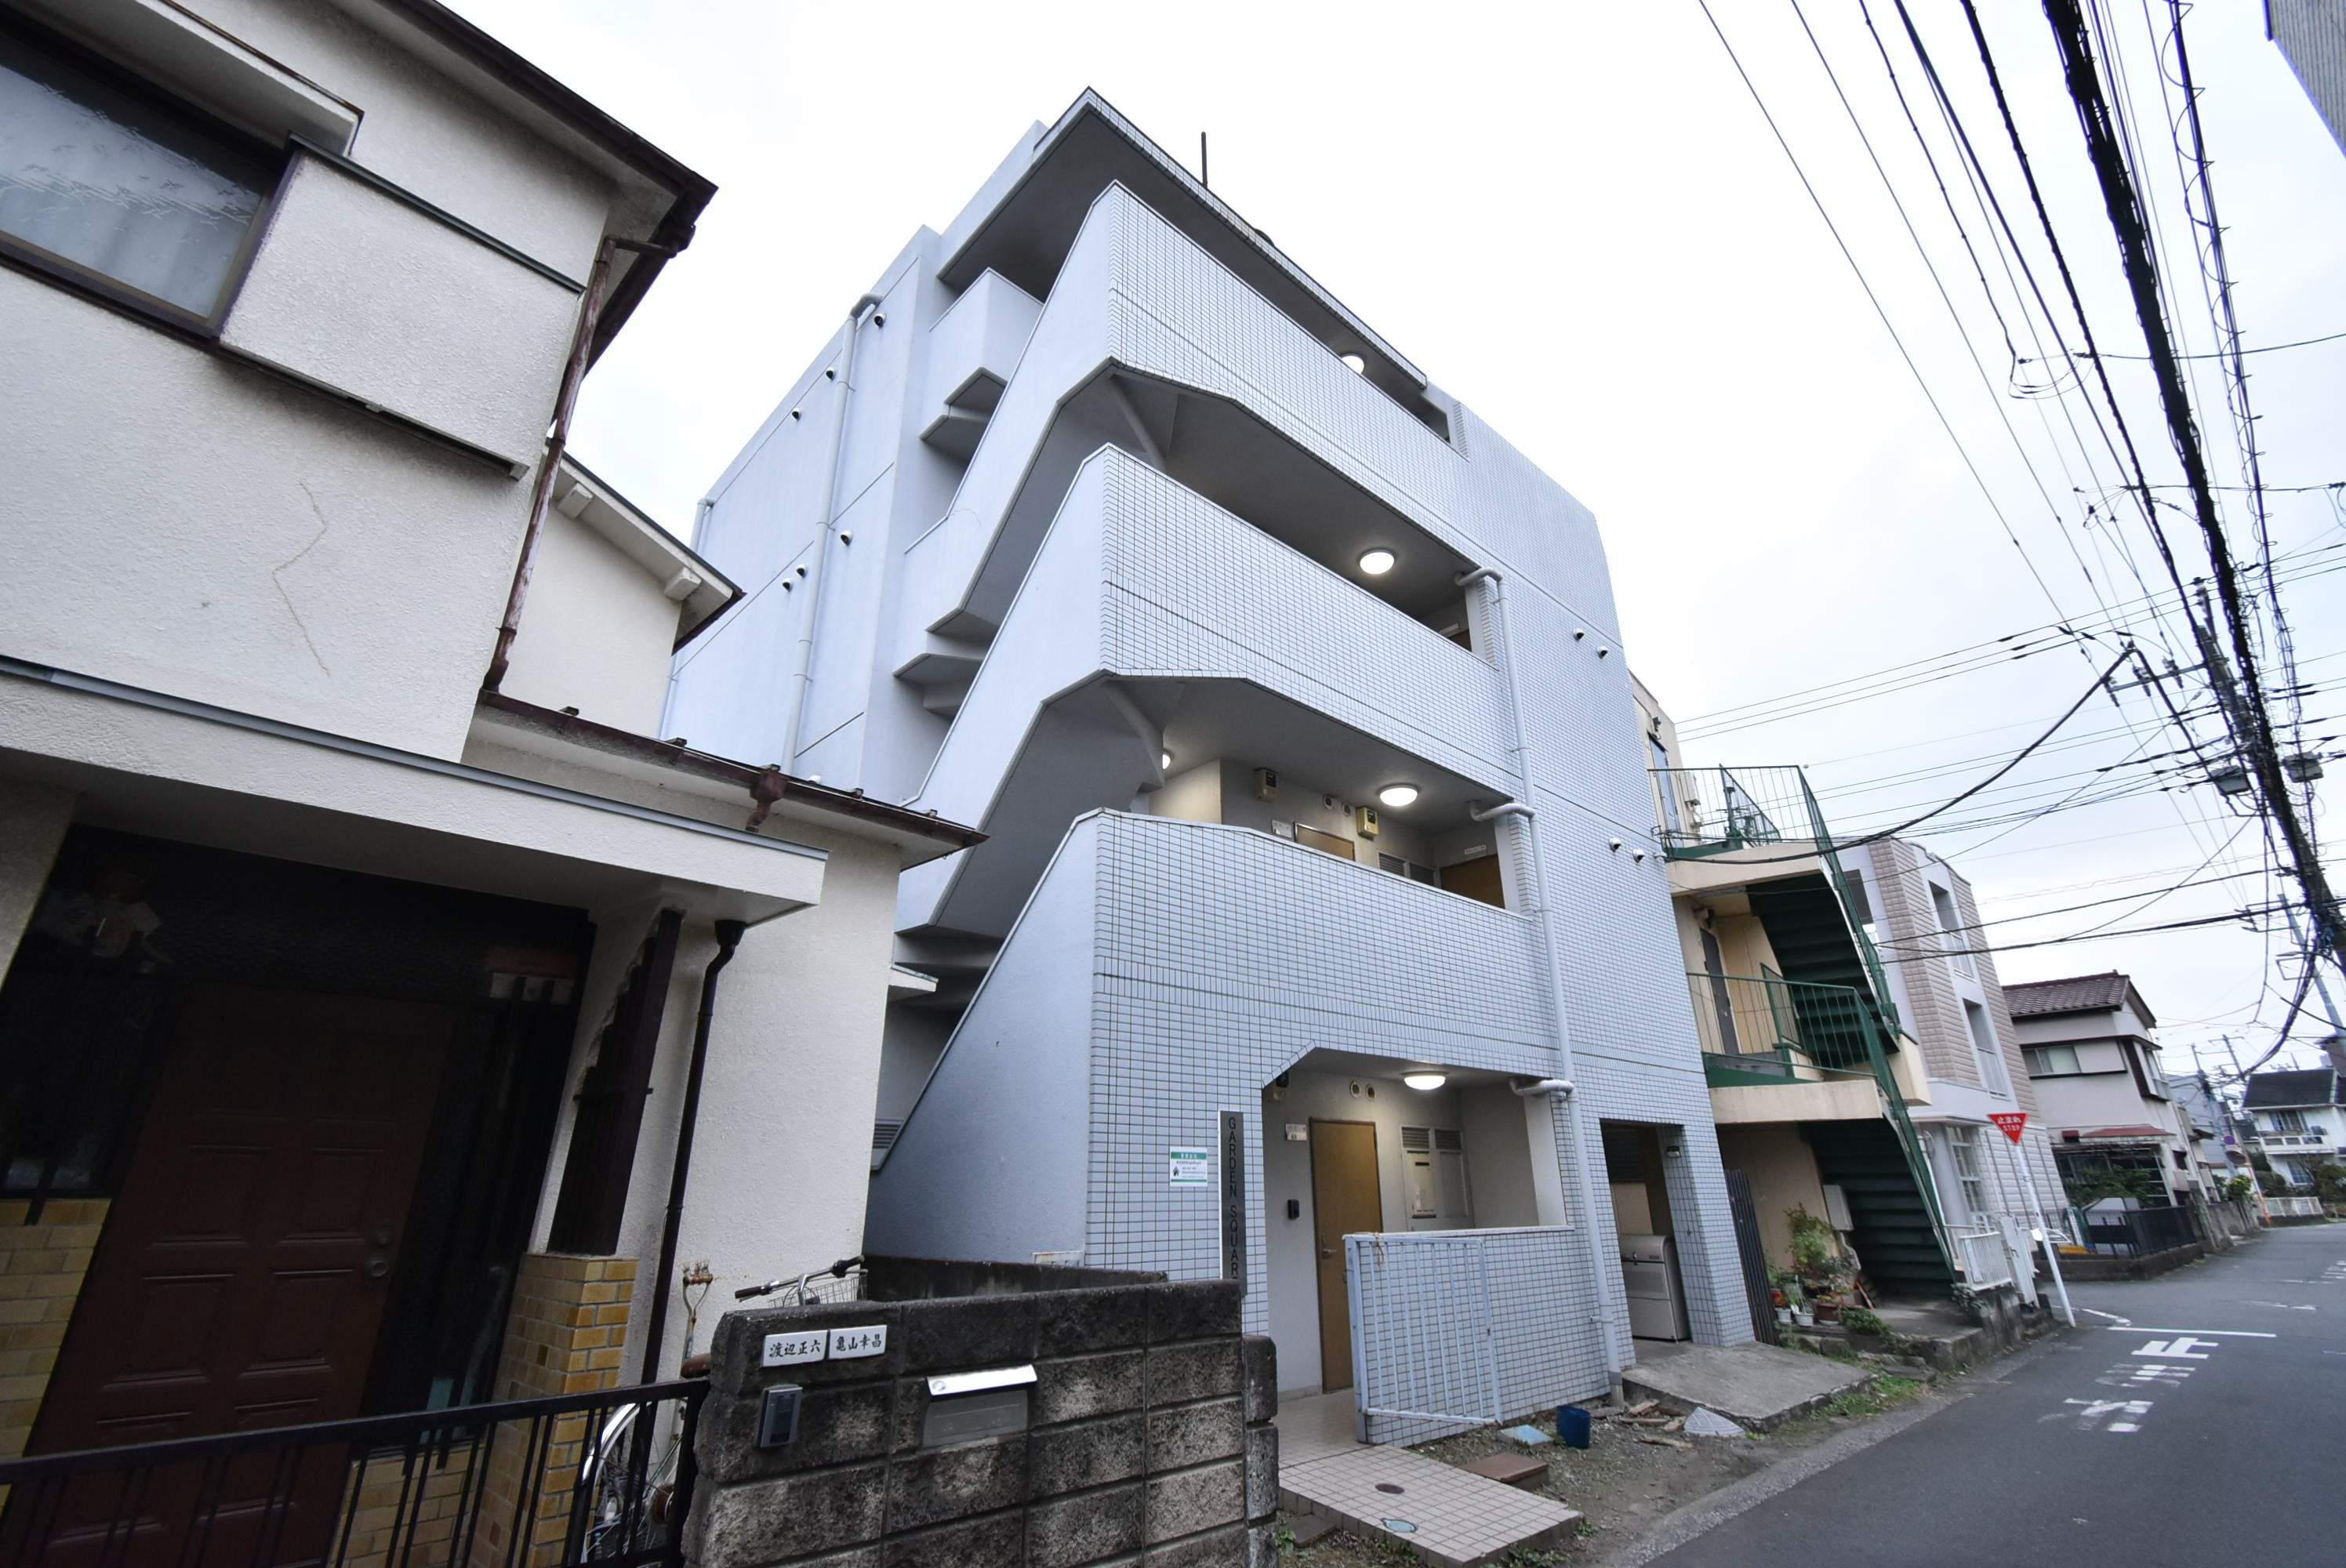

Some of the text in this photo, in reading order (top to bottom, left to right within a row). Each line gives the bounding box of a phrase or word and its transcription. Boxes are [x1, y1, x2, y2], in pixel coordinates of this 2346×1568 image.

[1997, 1116, 2022, 1124] 止まれ
[1229, 1205, 1238, 1279] SQUAR
